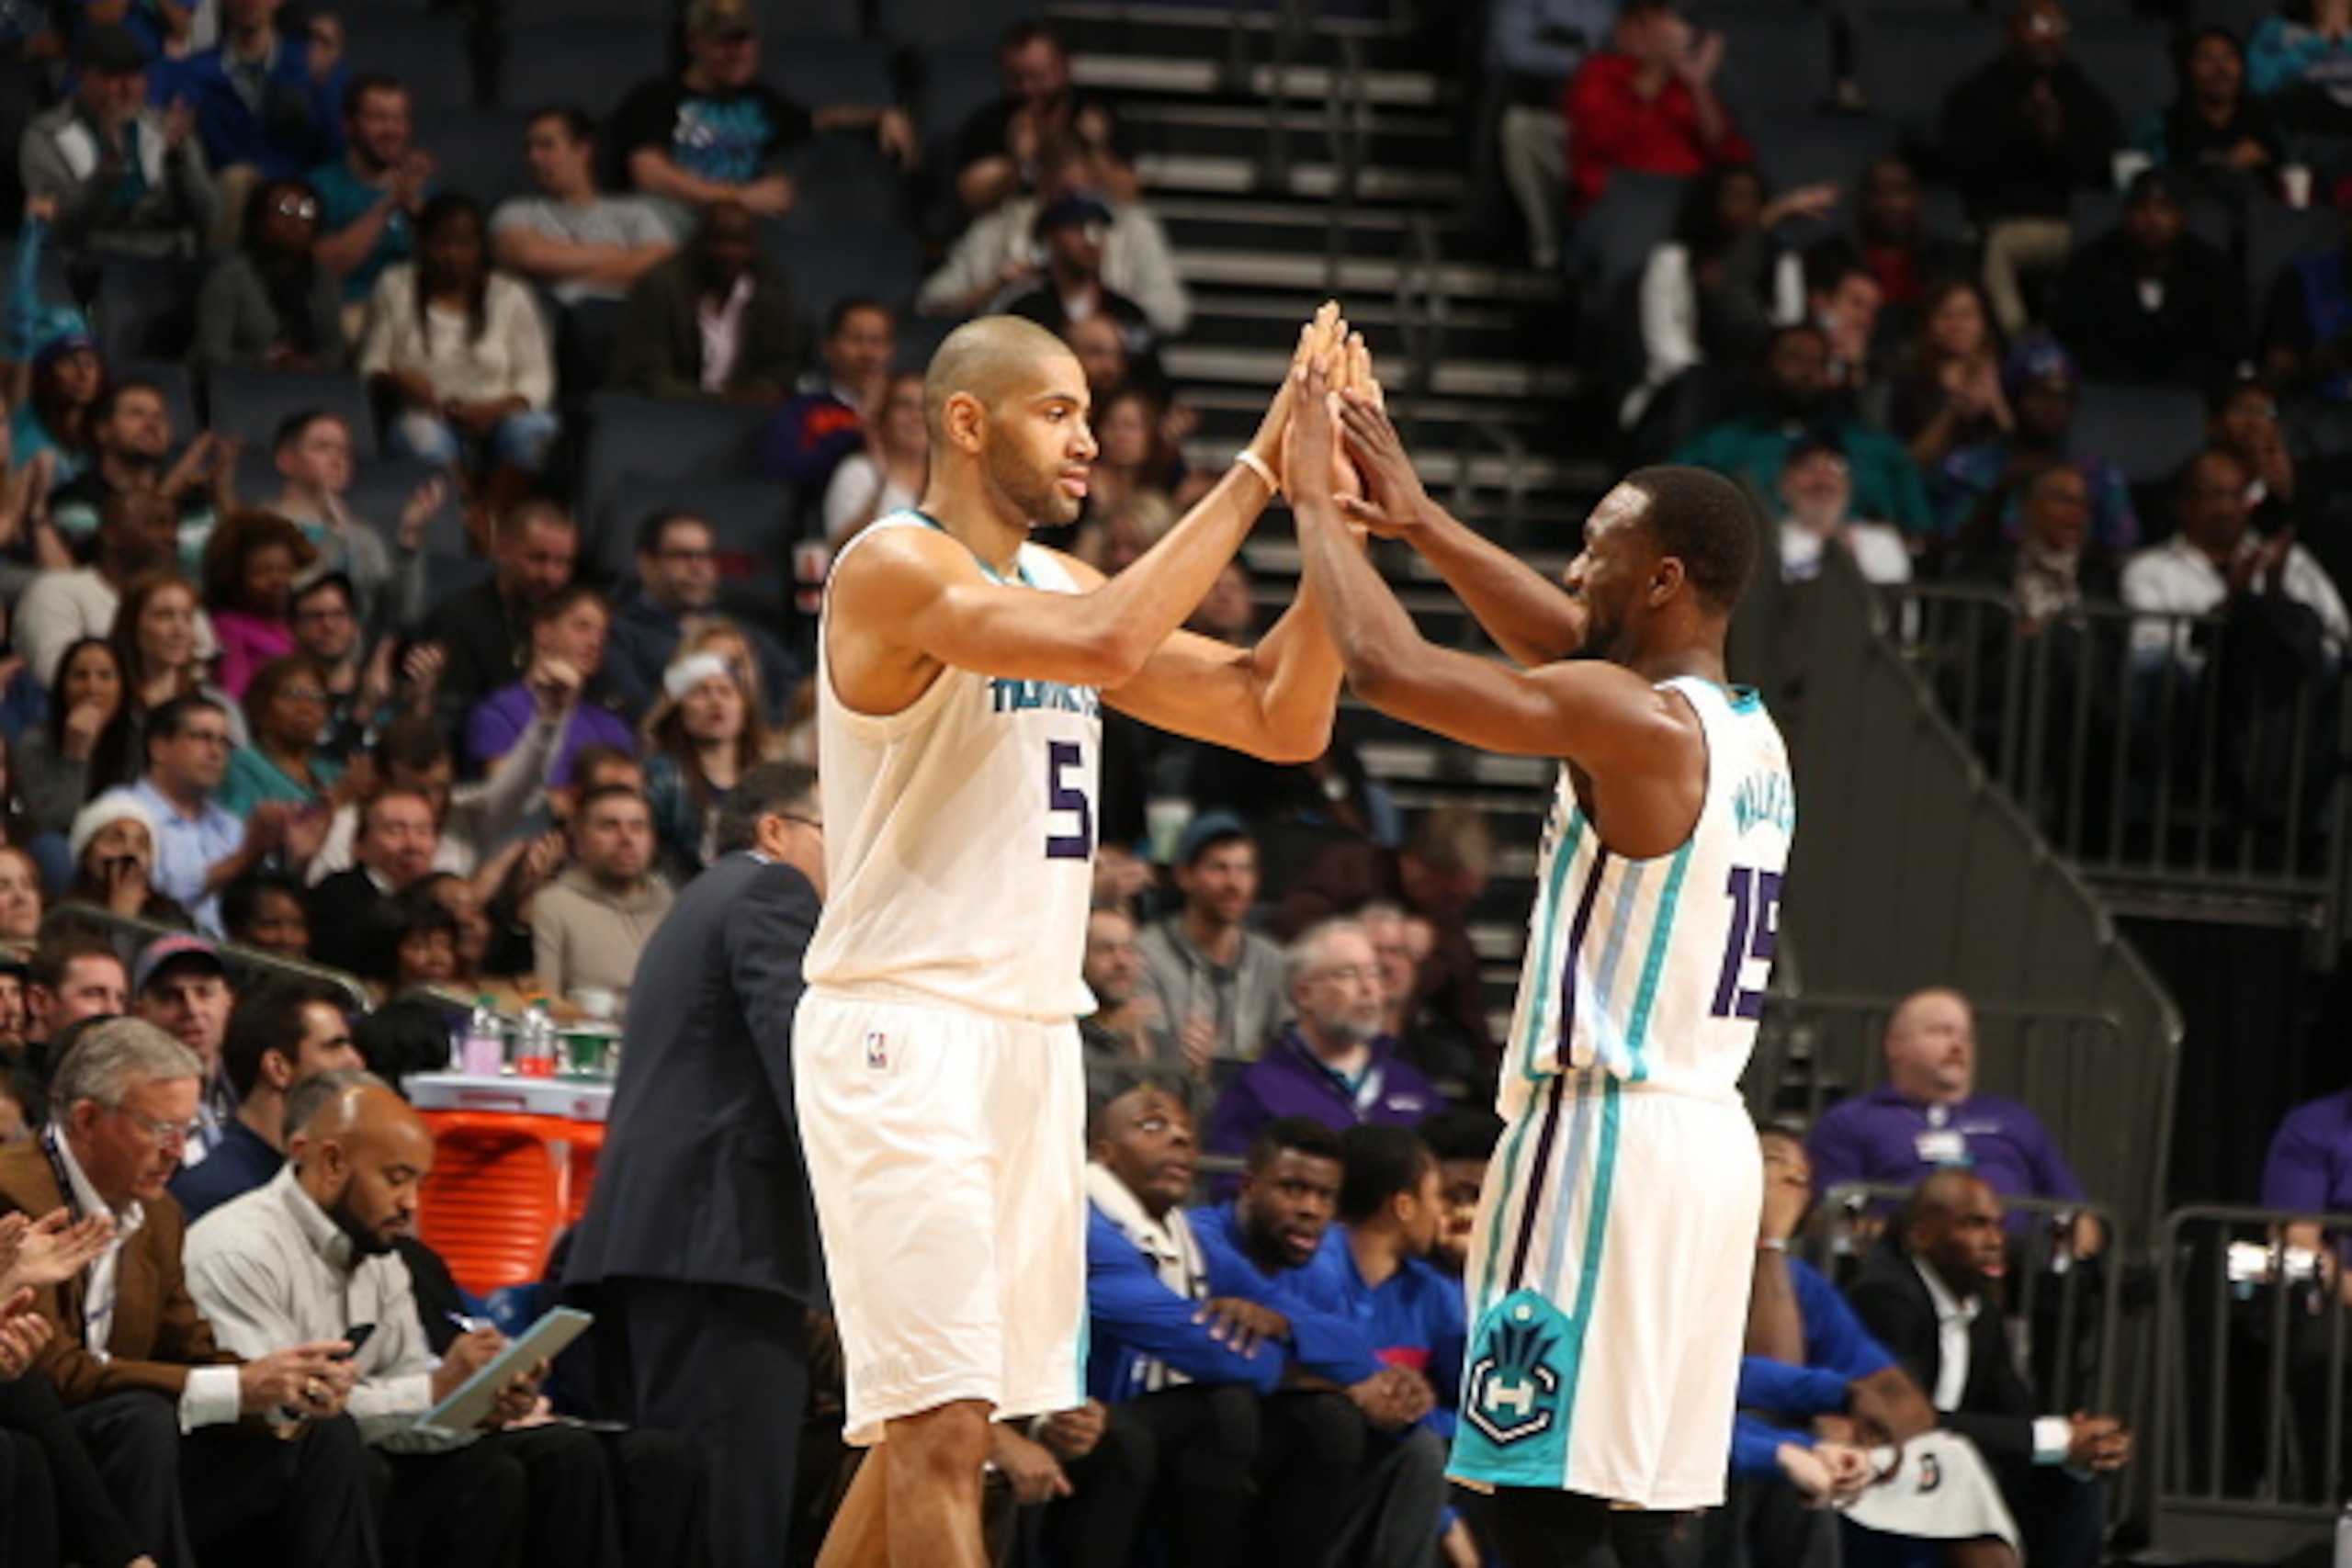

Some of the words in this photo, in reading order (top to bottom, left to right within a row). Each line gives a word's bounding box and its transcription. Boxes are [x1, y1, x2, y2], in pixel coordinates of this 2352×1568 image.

[1046, 739, 1091, 861] 5
[1730, 769, 1796, 837] WALKE
[1710, 863, 1784, 1020] 15
